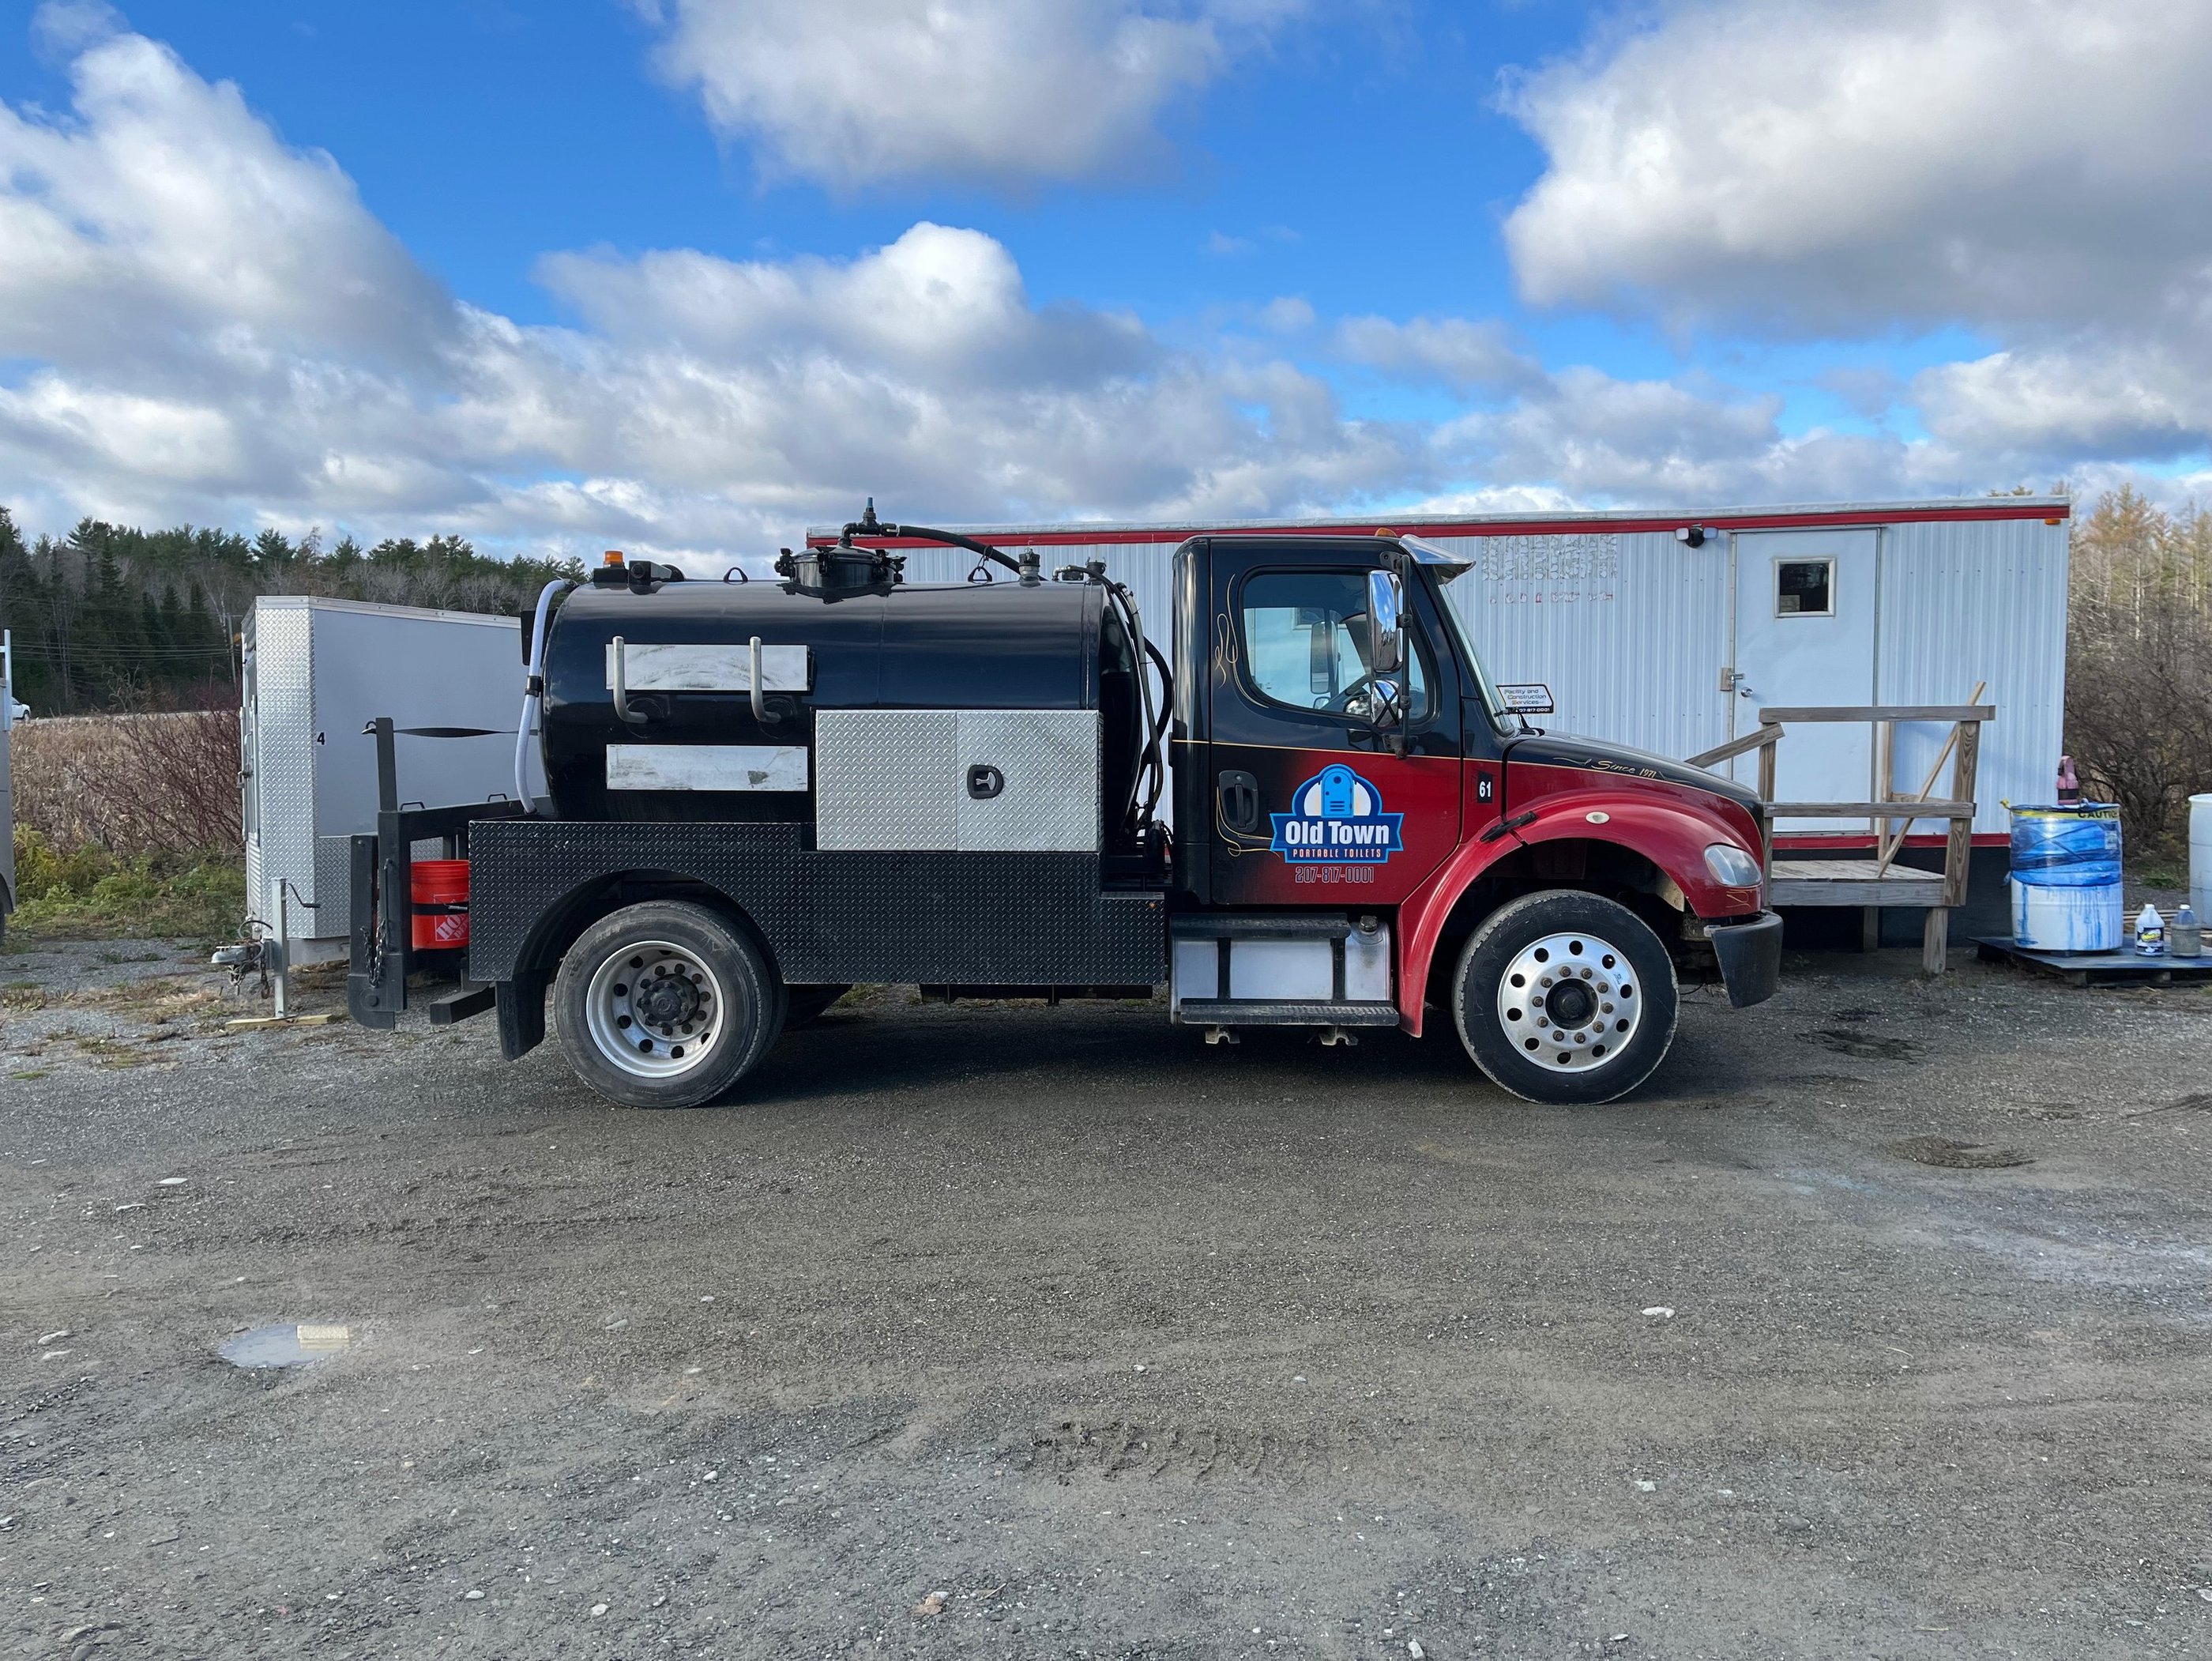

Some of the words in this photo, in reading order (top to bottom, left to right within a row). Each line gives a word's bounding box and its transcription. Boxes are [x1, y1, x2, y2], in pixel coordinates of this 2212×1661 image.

[317, 732, 325, 745] 4
[1591, 760, 1636, 774] Since
[1639, 768, 1657, 778] 1971
[1480, 781, 1491, 797] 61
[1285, 821, 1323, 845] Old
[1328, 821, 1390, 845] Town
[1292, 849, 1339, 857] PORTABLE
[1344, 849, 1381, 857] TOILETS
[1295, 866, 1375, 883] 207-817-0001
